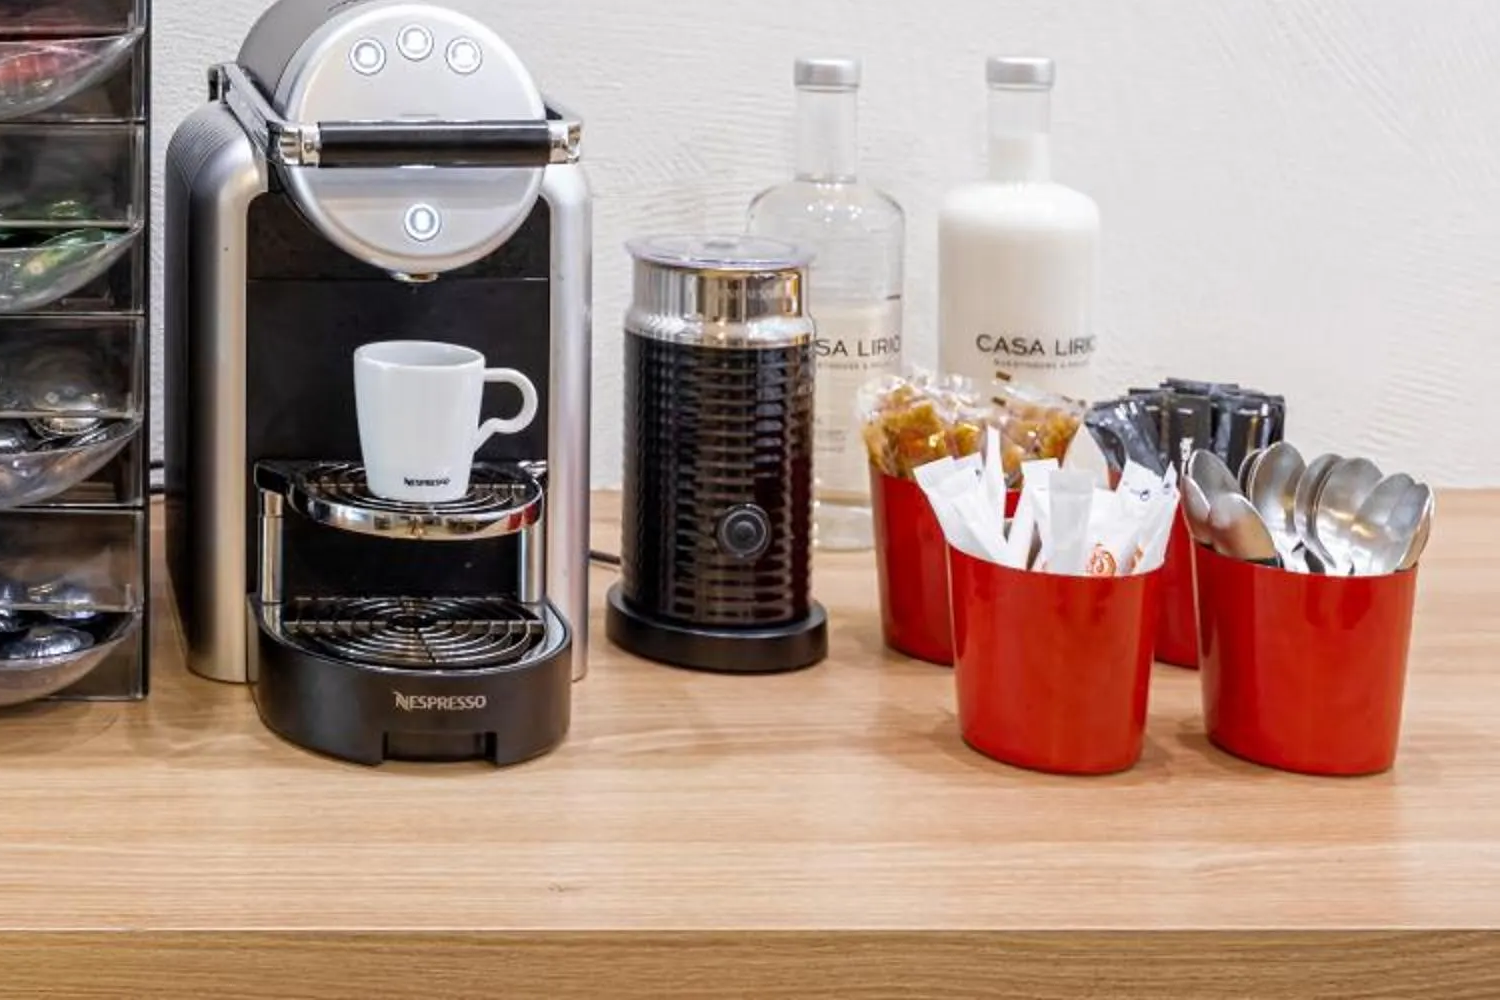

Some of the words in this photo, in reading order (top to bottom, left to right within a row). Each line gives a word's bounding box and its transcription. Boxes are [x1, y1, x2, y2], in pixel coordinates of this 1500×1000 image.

[813, 338, 848, 357] SA
[975, 333, 1045, 356] CASA
[394, 690, 487, 711] NESPRESSO
